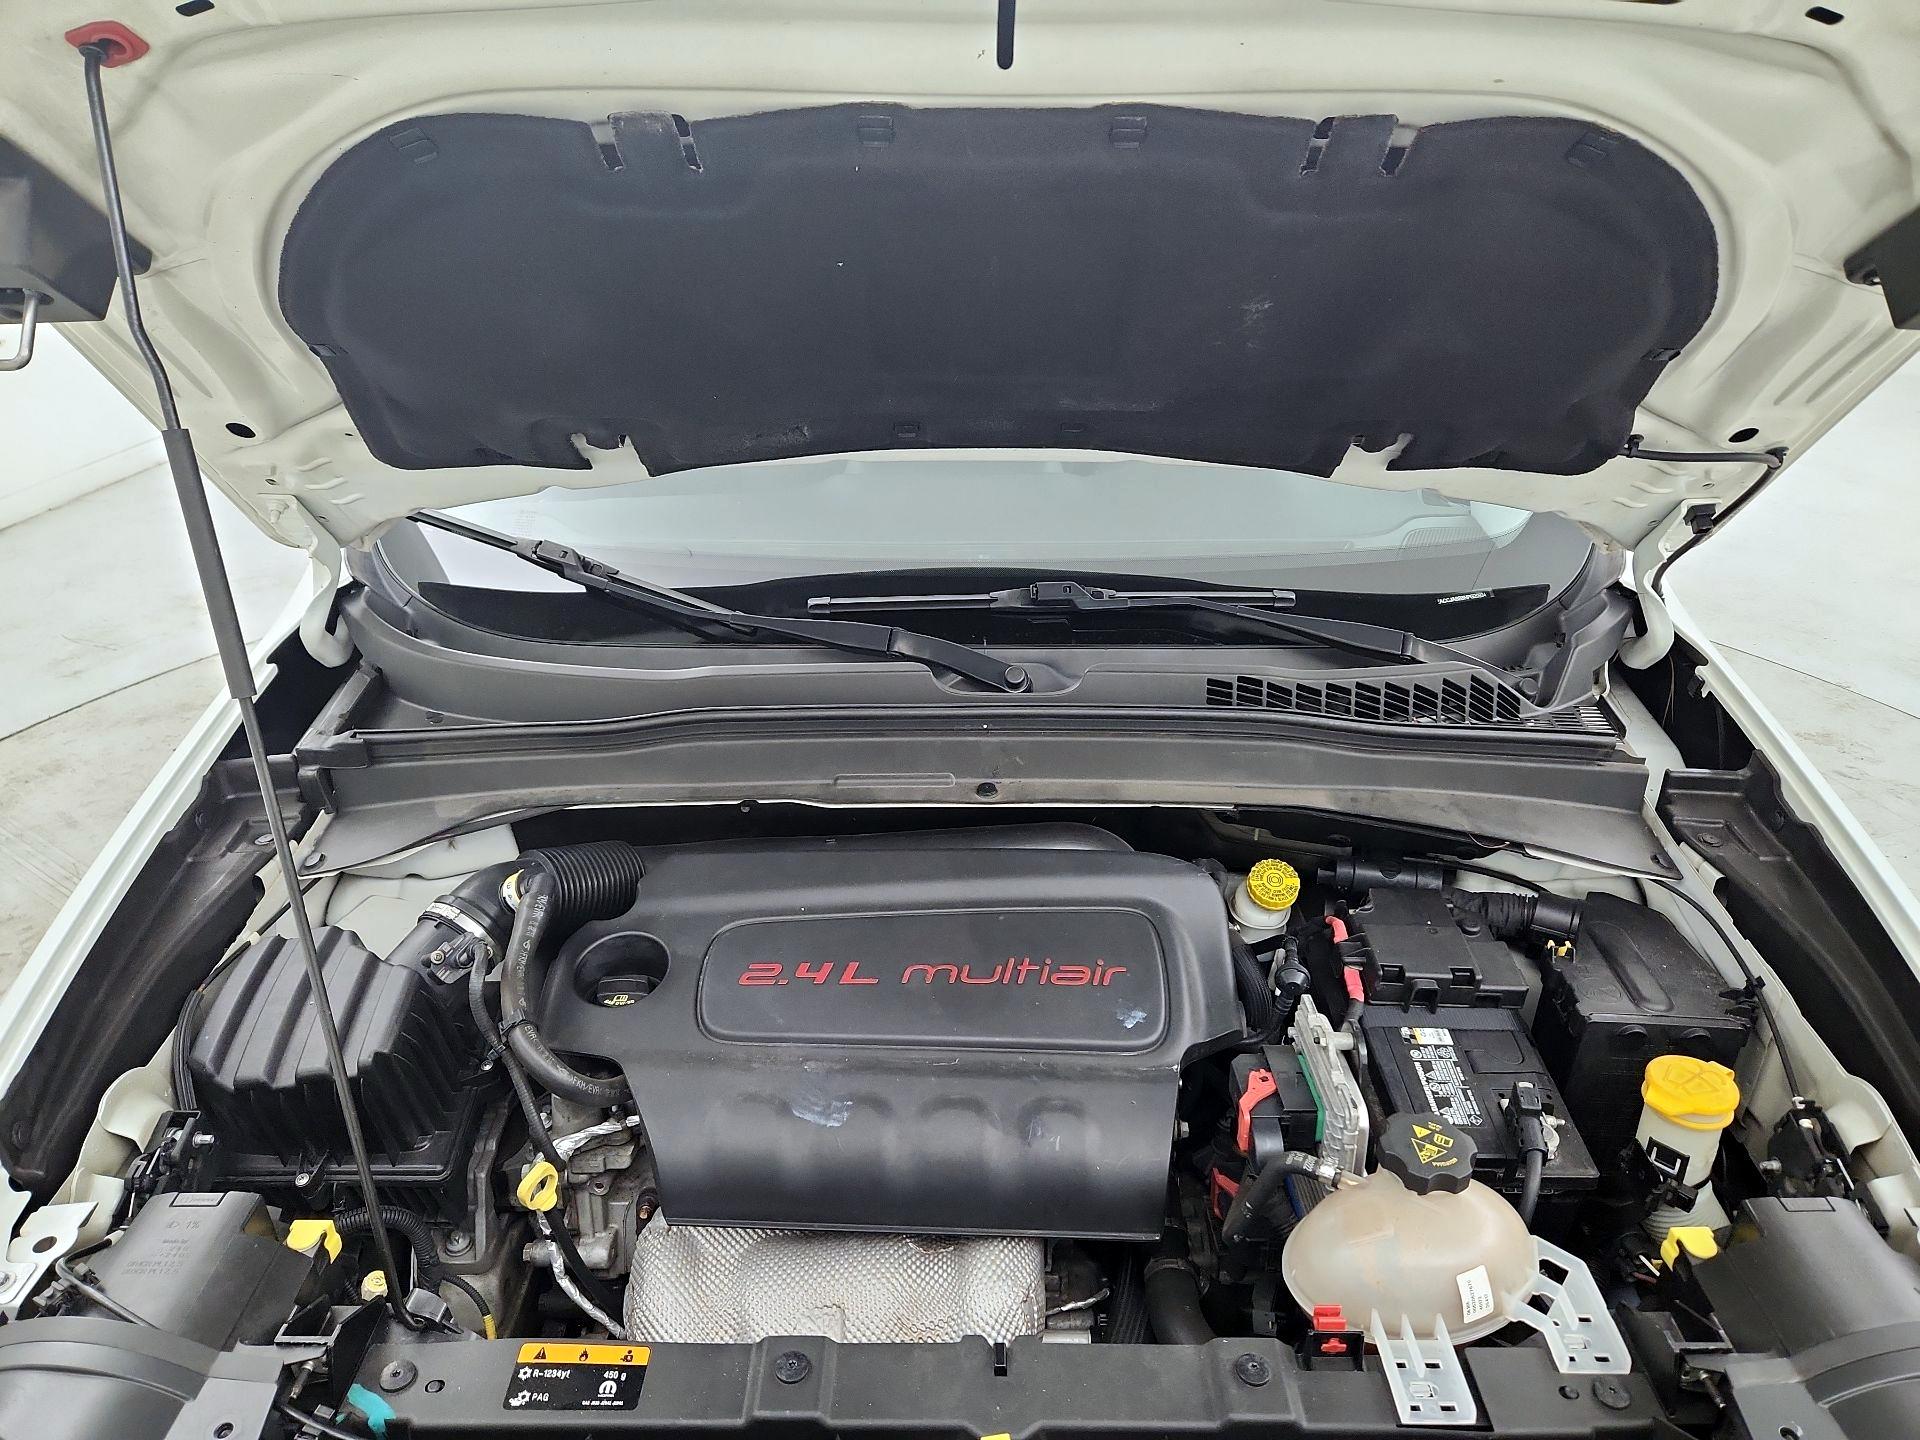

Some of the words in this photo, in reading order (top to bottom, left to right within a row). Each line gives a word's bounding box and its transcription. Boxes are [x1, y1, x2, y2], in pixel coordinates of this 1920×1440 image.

[901, 956, 1128, 987] multiair
[604, 1370, 619, 1379] 450
[620, 1372, 627, 1381] g
[531, 1393, 549, 1402] PAG
